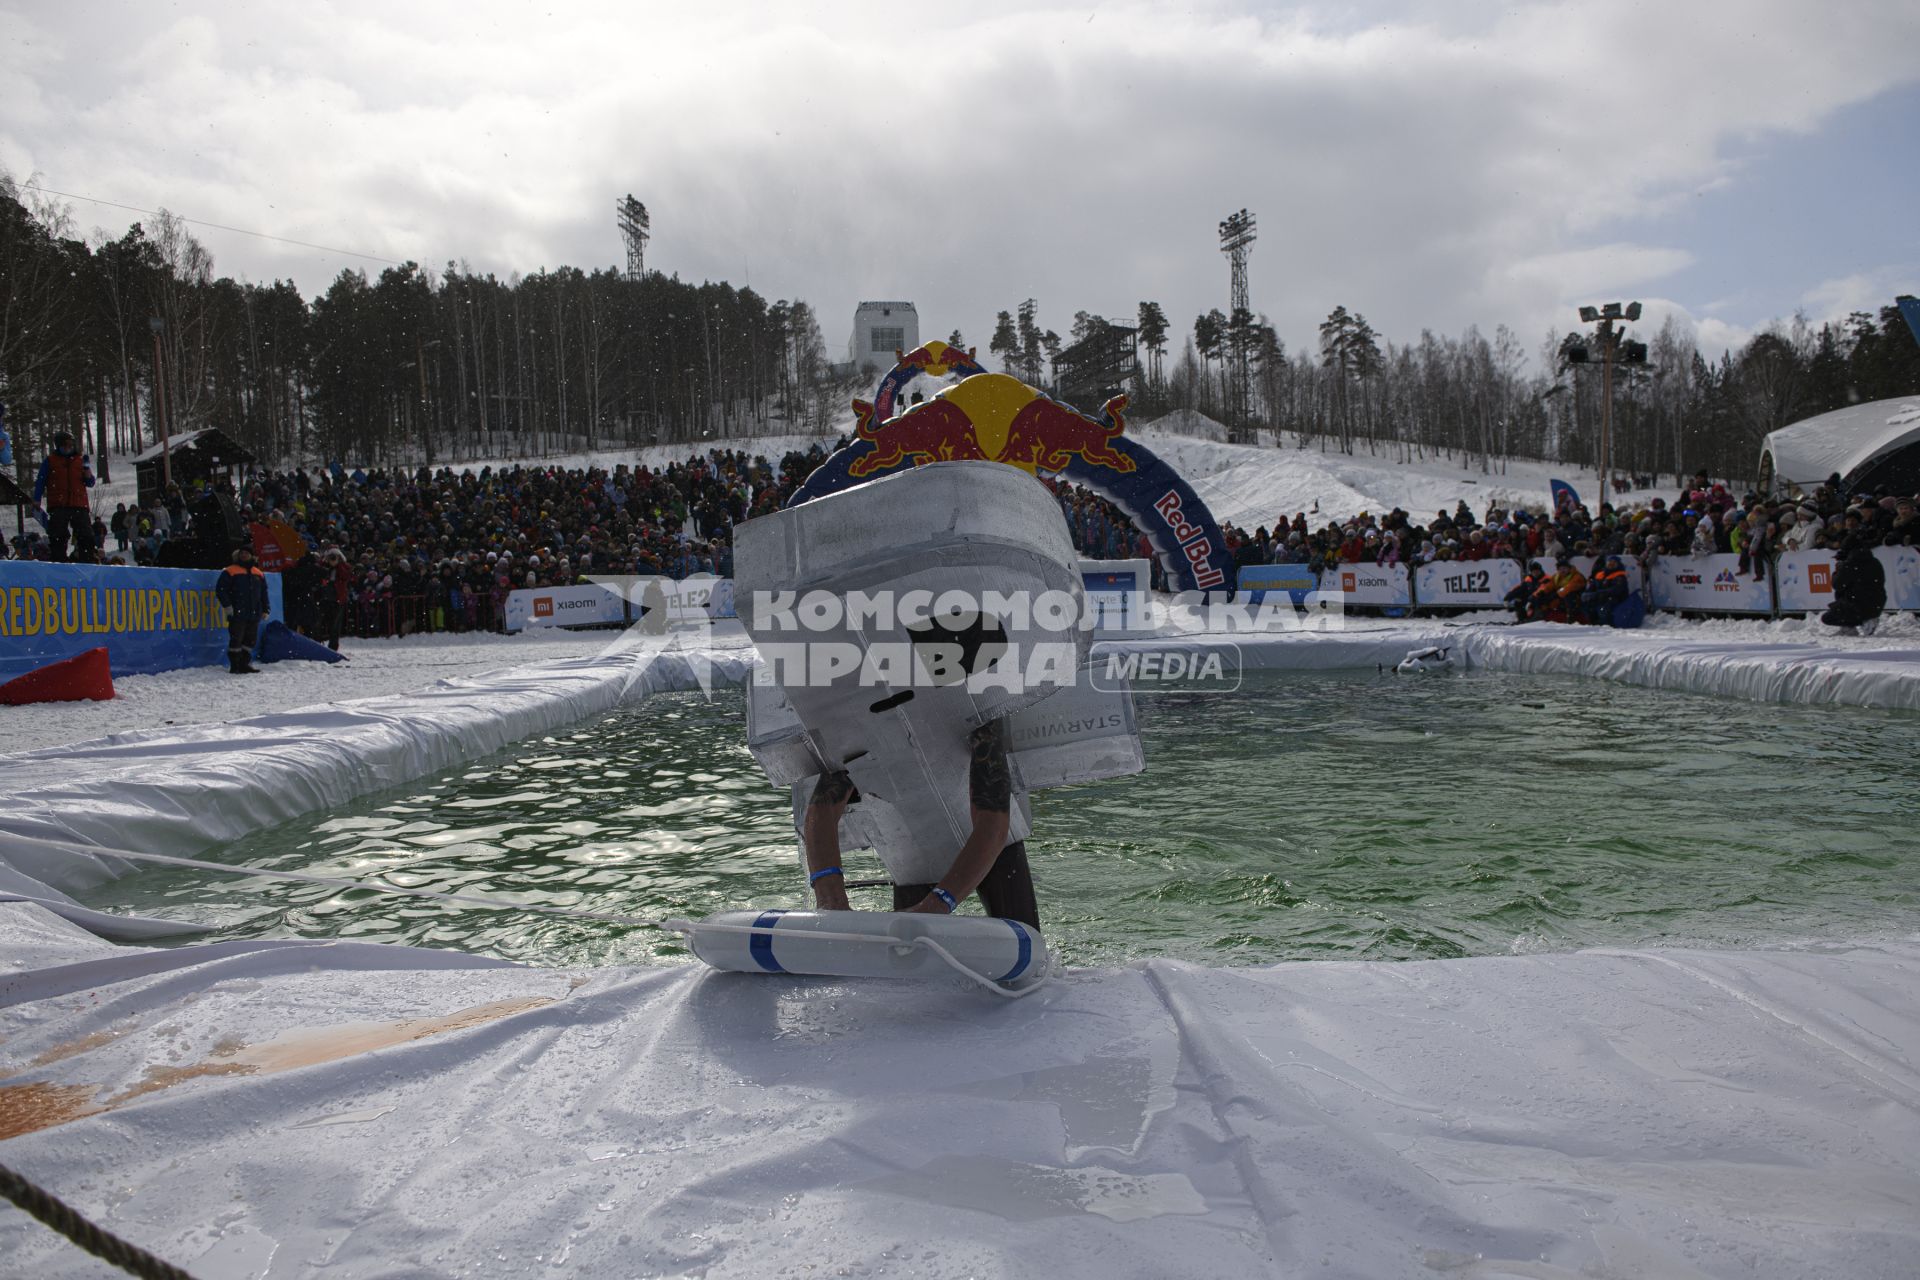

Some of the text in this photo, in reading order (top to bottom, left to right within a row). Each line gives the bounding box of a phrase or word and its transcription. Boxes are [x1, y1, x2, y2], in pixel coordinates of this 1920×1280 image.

[1154, 489, 1225, 590] Red Bull
[1443, 570, 1491, 593] TELE2
